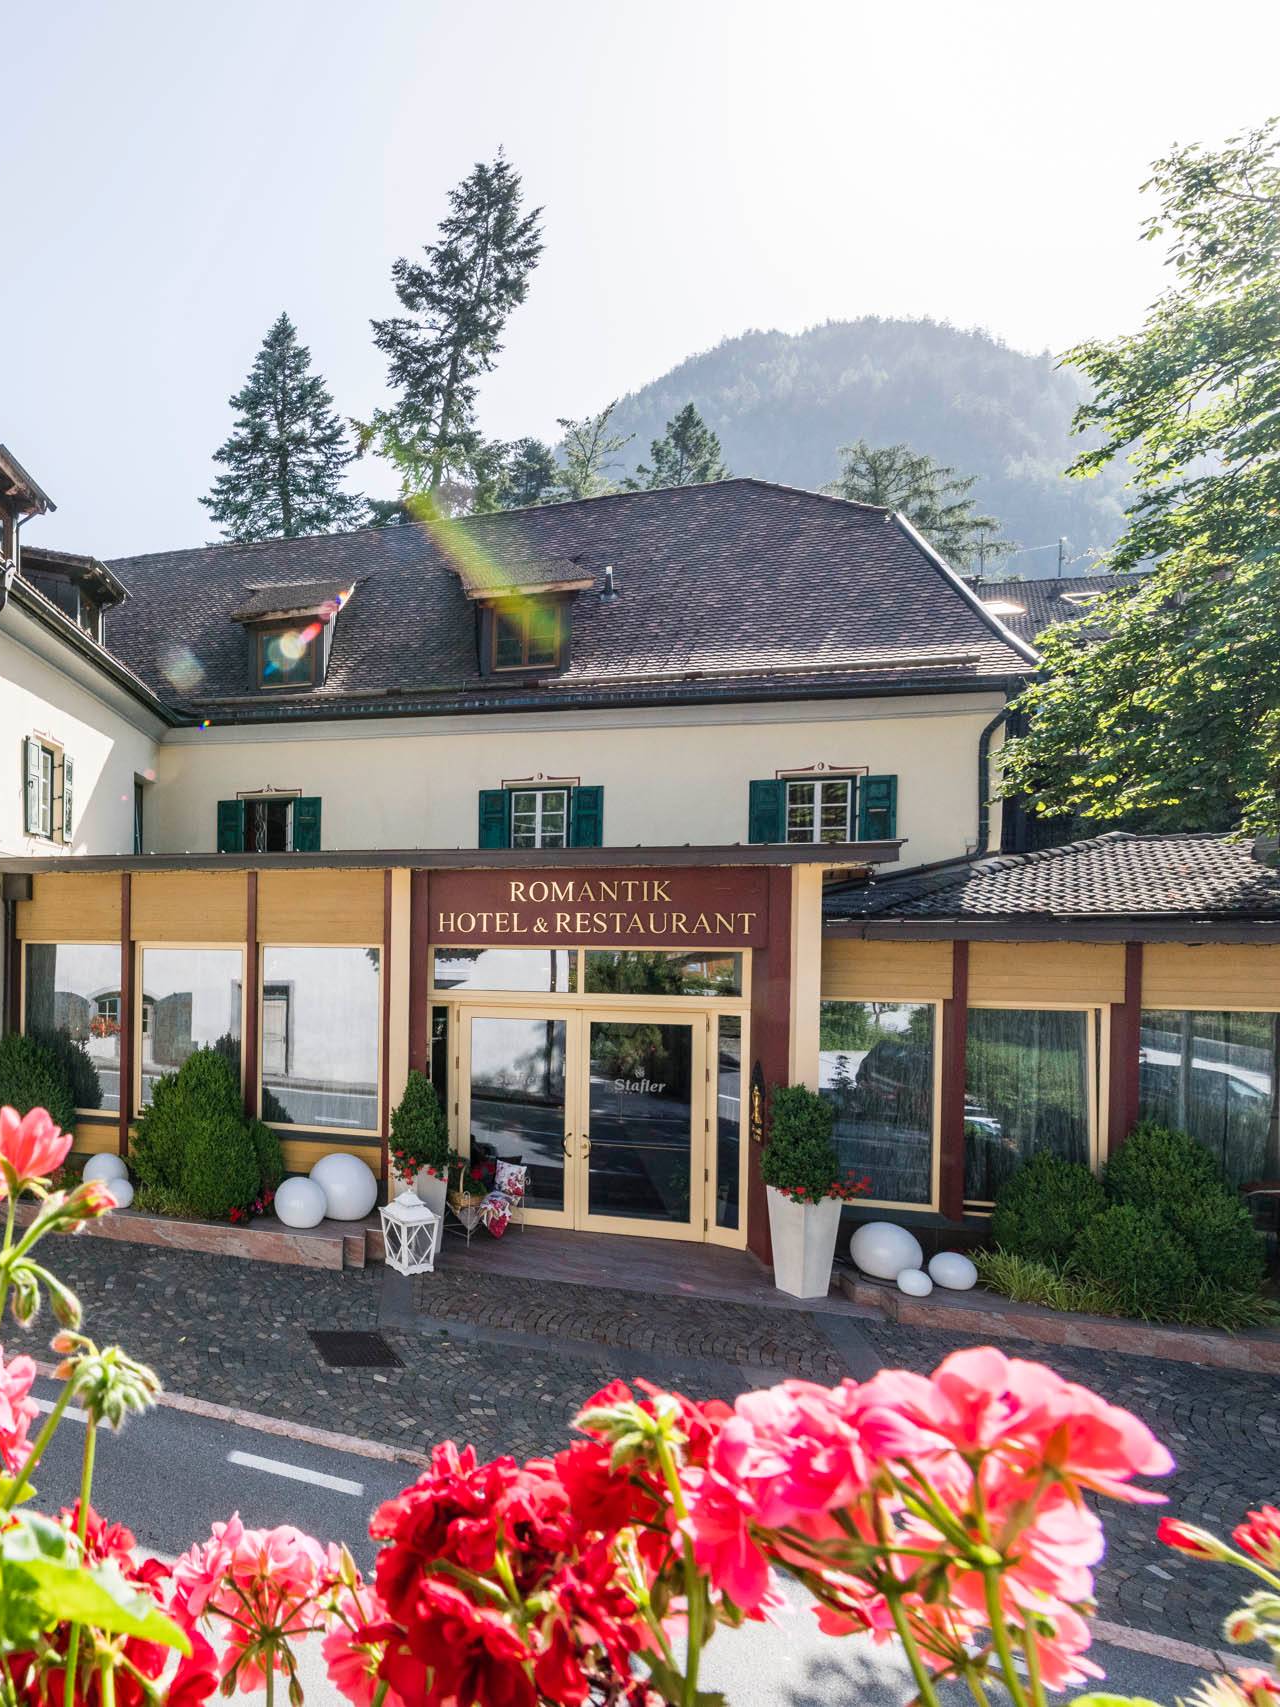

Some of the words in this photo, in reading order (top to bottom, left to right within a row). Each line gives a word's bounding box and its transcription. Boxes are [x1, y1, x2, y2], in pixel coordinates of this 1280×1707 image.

[509, 880, 673, 903] ROMANTIK
[438, 912, 528, 934] HOTEL
[533, 917, 549, 934] &
[555, 911, 757, 936] RESTAURANT
[614, 1078, 666, 1093] Stafler
